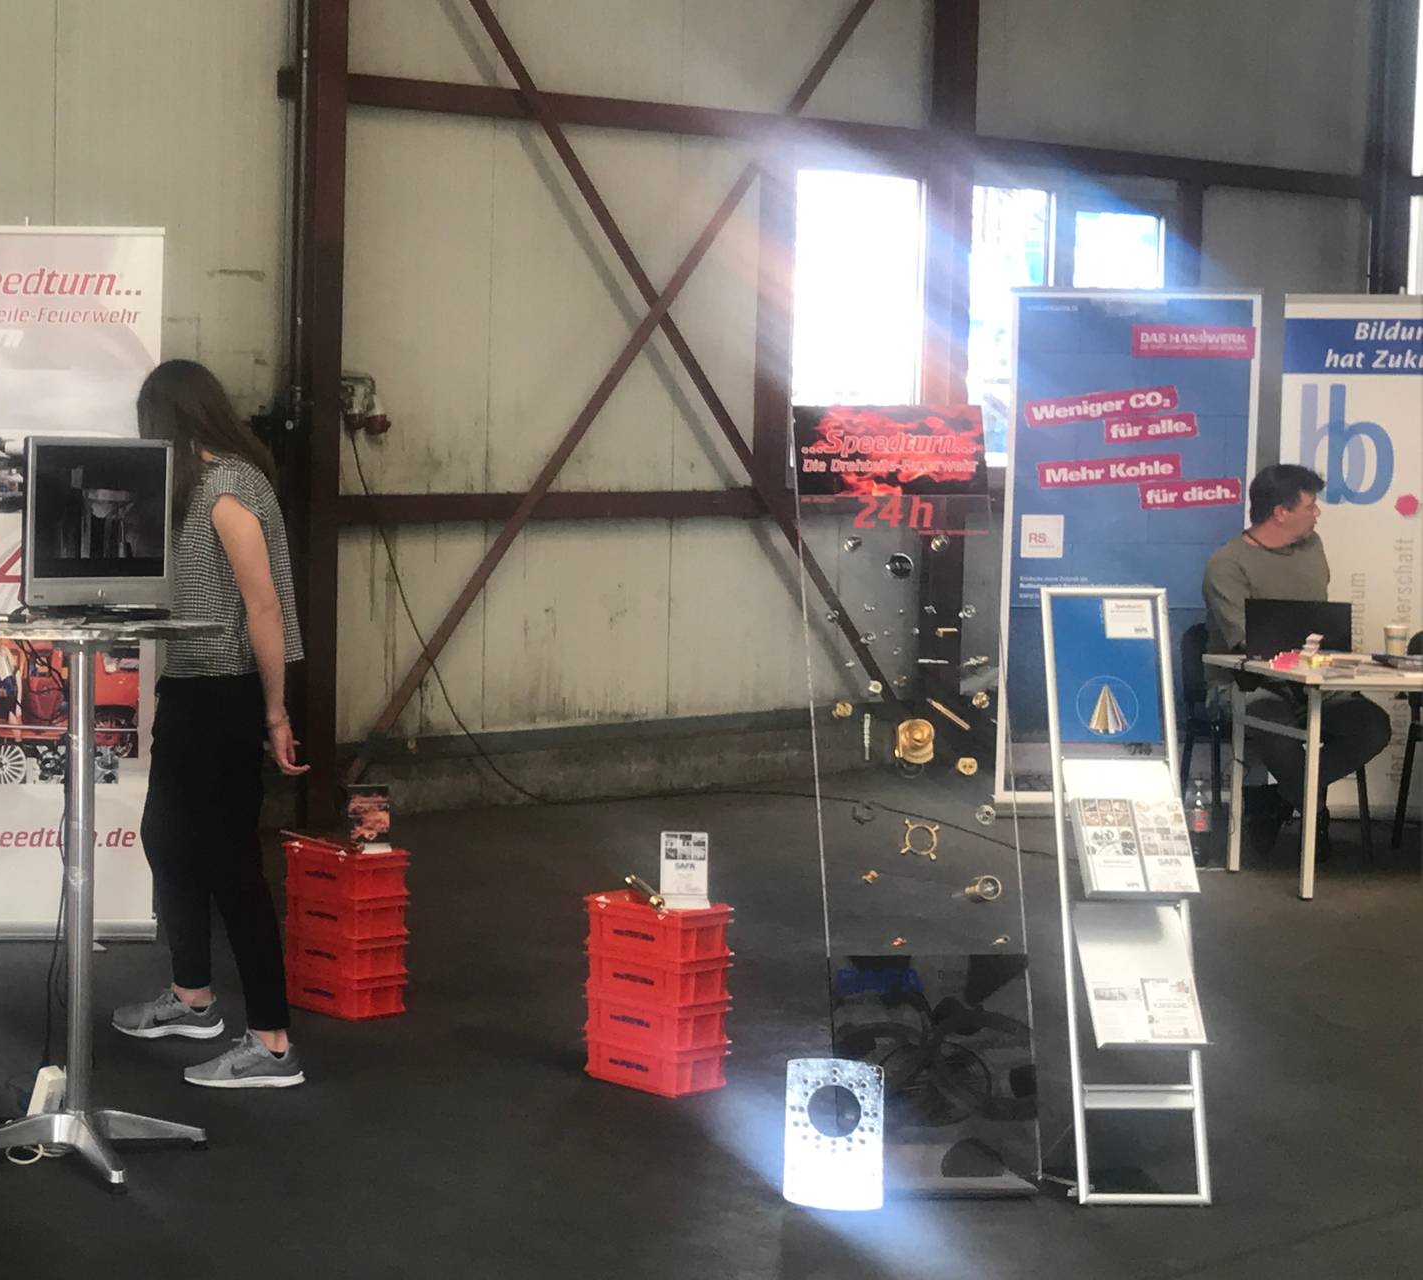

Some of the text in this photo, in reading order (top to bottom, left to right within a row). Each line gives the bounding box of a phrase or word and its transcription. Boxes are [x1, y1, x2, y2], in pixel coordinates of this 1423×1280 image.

[1140, 332, 1167, 344] DAS
[1325, 349, 1365, 369] hat
[1032, 399, 1125, 421] Weniger
[1110, 419, 1192, 439] für alle.
[1045, 460, 1174, 484] Mehr Kohle
[1146, 485, 1237, 505] für dich.
[1028, 532, 1048, 544] RS
